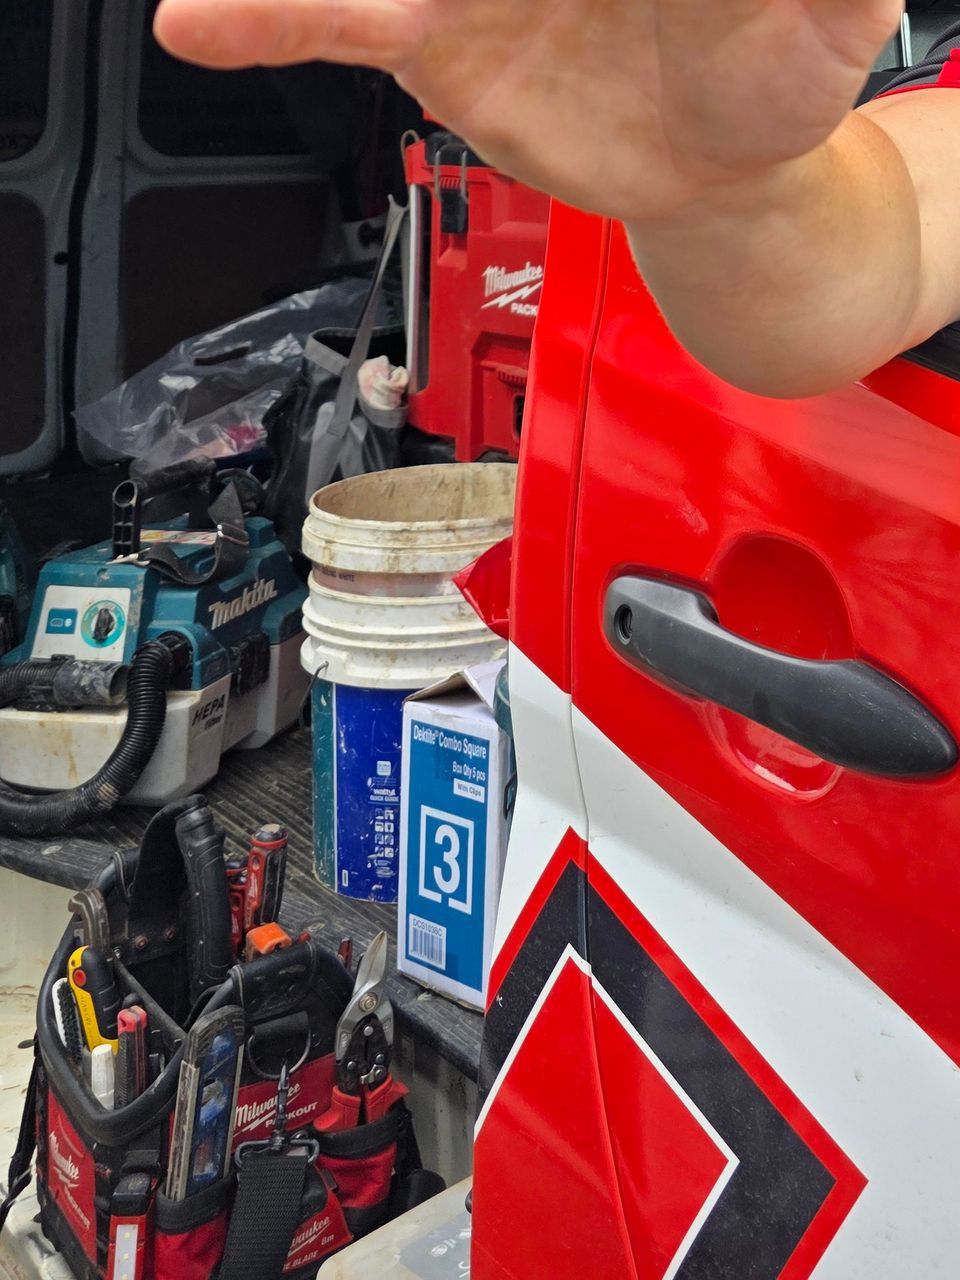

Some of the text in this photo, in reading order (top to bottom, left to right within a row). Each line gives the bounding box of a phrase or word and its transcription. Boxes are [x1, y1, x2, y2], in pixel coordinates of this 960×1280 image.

[481, 261, 543, 297] Milwaukee
[192, 694, 226, 727] HEPA
[439, 731, 462, 752] Combo
[463, 738, 486, 759] Square
[453, 761, 462, 775] Box
[463, 764, 472, 780] Qty
[476, 771, 486, 782] pcs
[433, 823, 461, 894] 3
[233, 1082, 301, 1131] Milwaee
